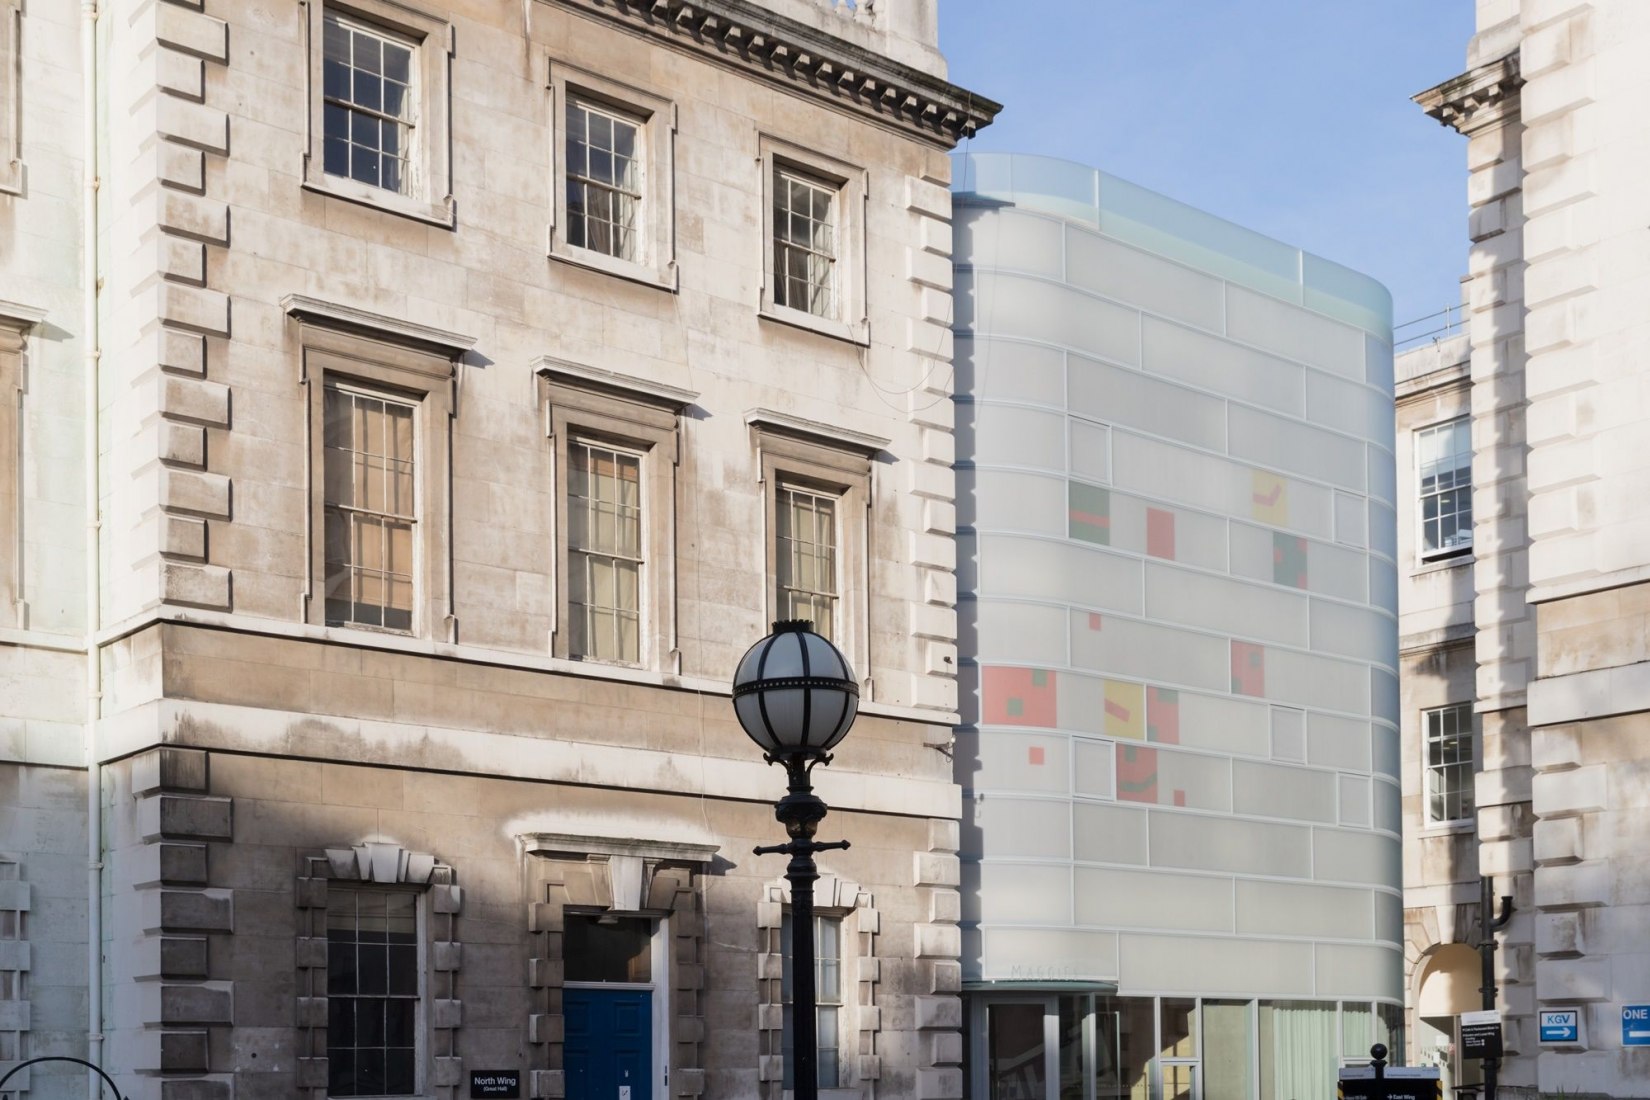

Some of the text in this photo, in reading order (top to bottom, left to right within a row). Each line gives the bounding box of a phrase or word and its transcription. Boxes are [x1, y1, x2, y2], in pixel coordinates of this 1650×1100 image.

[1547, 1014, 1570, 1024] KGV
[1623, 1009, 1648, 1020] ONE
[474, 1076, 516, 1087] North Wing
